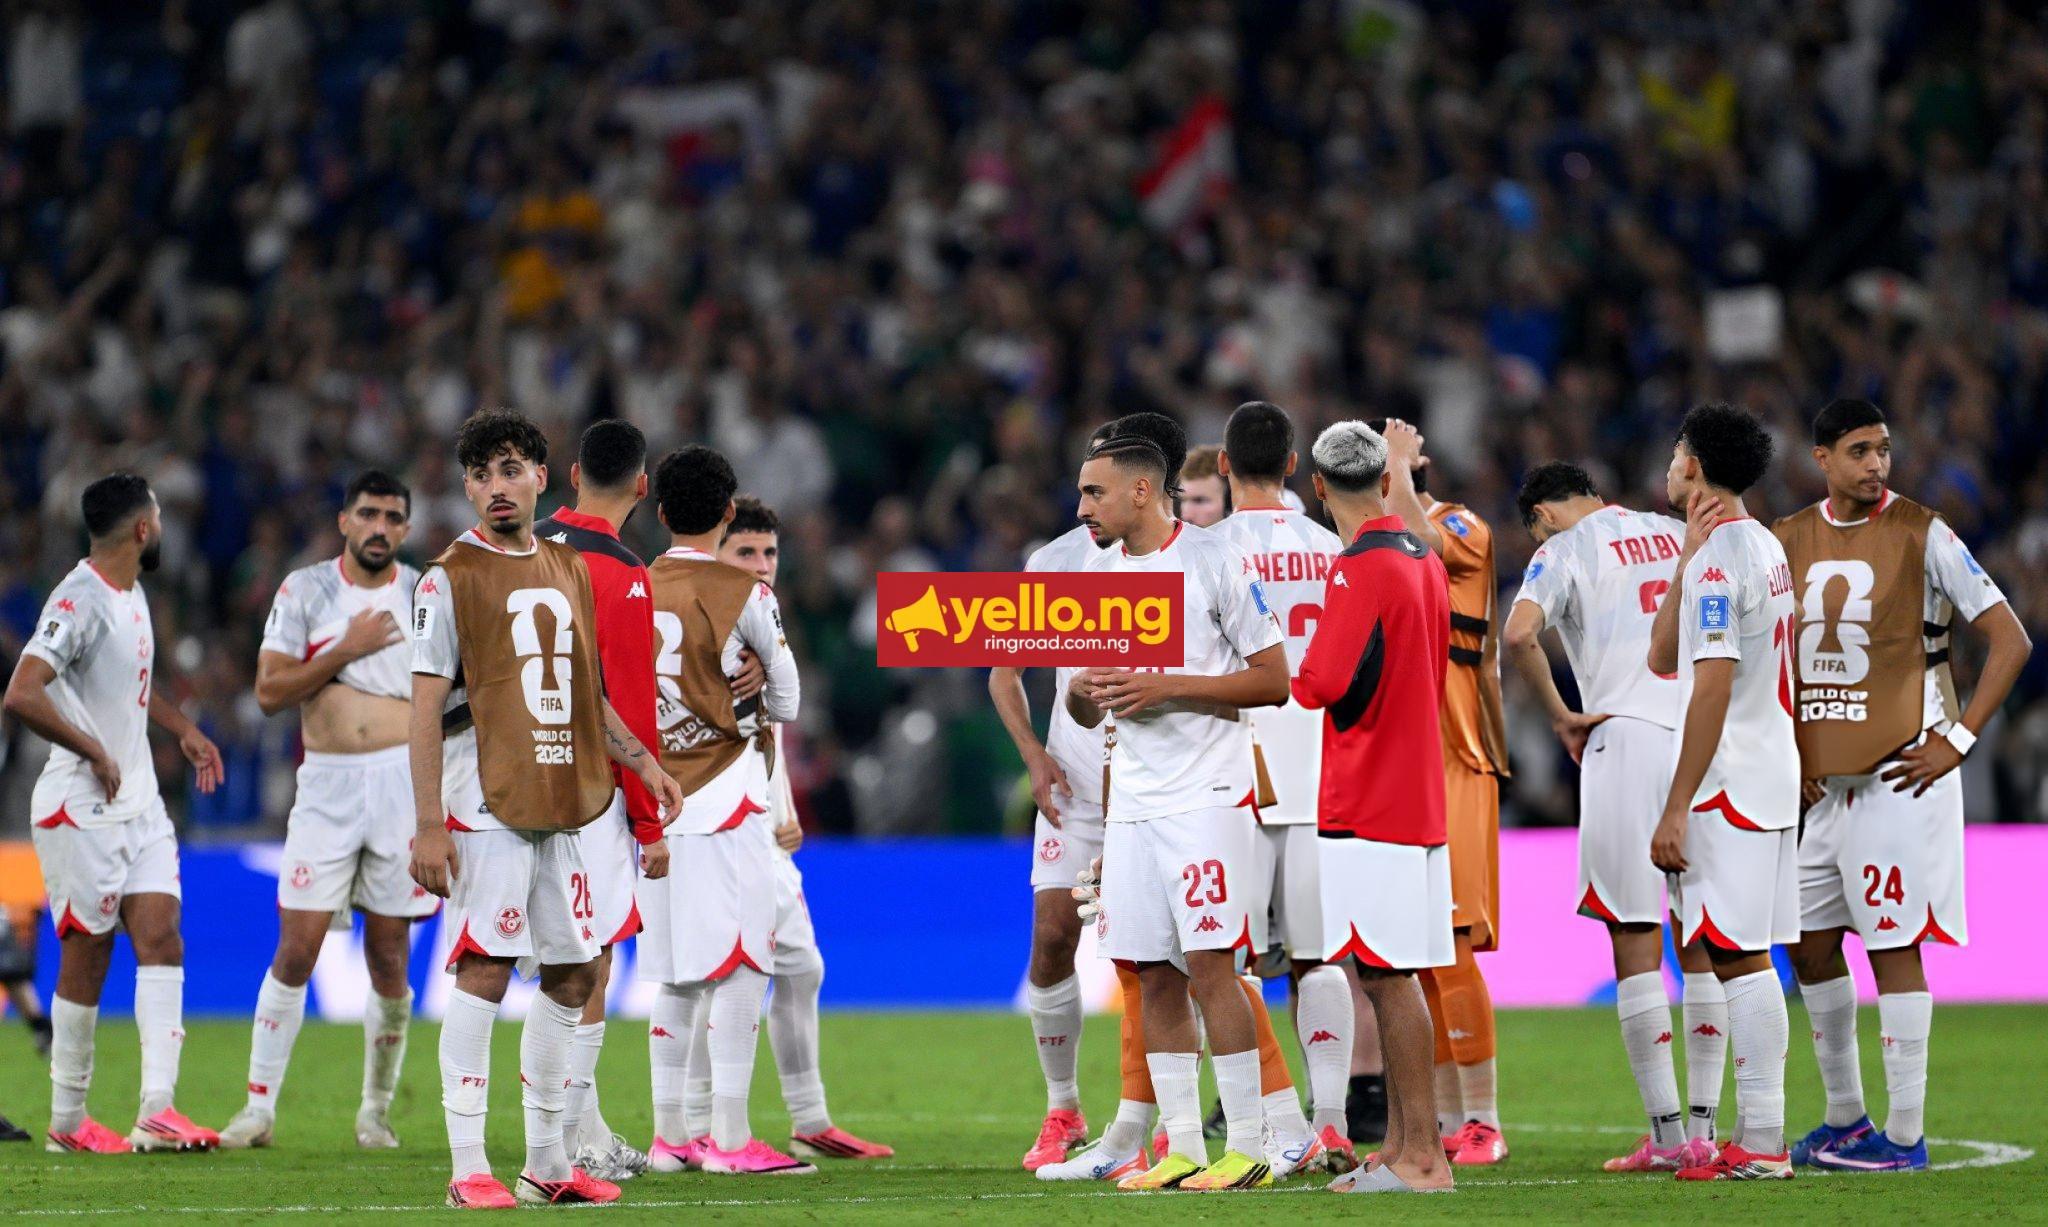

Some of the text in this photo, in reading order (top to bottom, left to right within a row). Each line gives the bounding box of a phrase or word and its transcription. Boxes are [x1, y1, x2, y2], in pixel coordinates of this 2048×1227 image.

[1608, 533, 1682, 566] TALBI
[1813, 659, 1847, 673] FIFA
[540, 697, 564, 712] FIFA
[534, 745, 573, 765] 2026
[570, 872, 593, 919] 26
[1182, 859, 1228, 908] 23
[1863, 864, 1905, 907] 24
[1039, 1034, 1067, 1046] FTF
